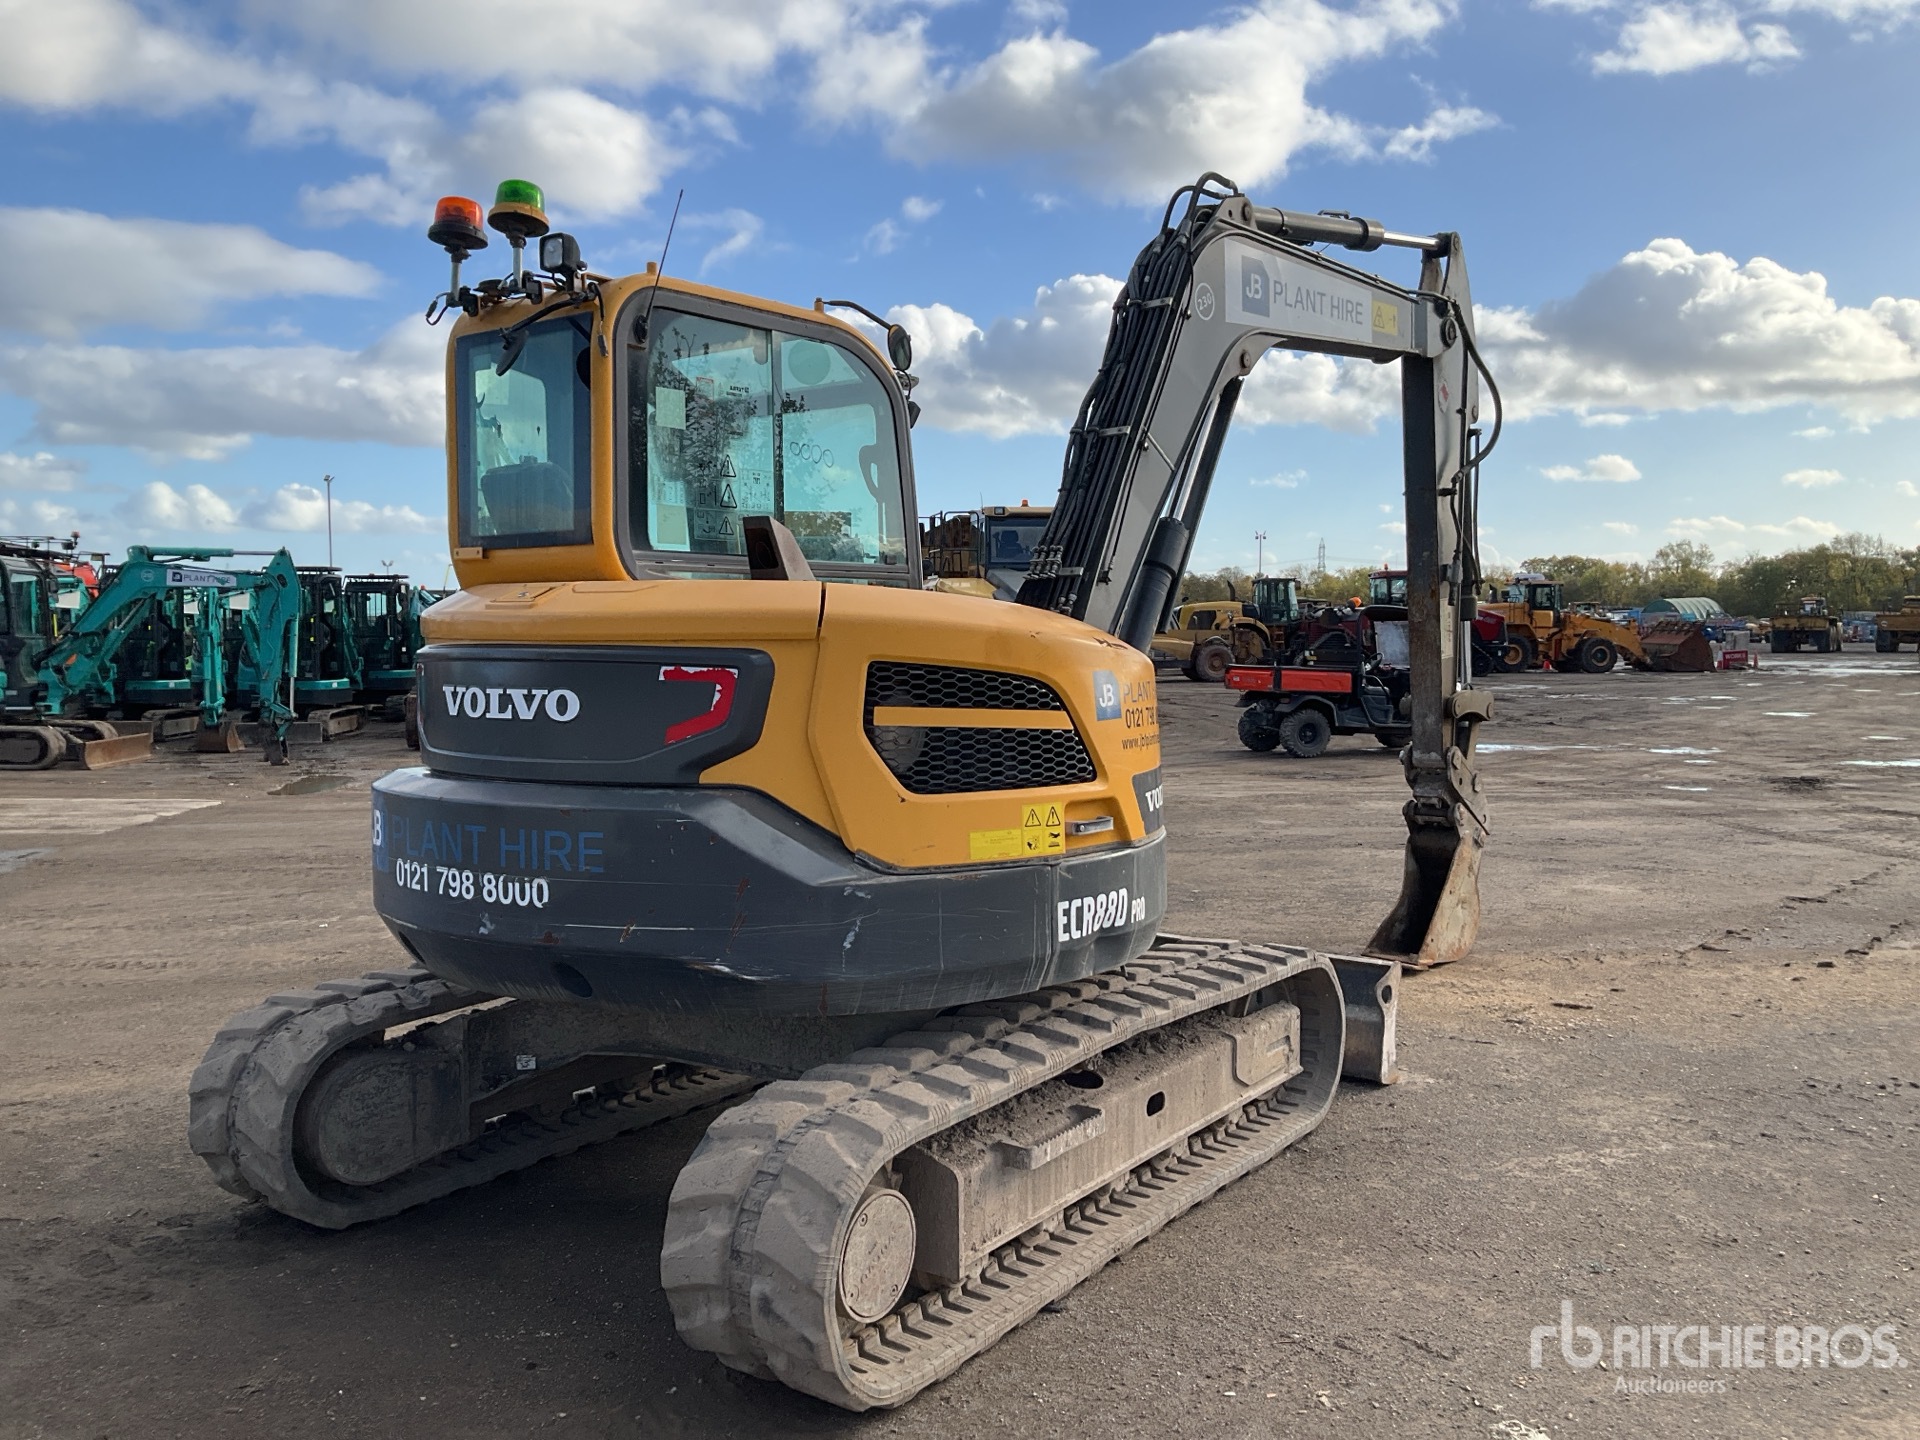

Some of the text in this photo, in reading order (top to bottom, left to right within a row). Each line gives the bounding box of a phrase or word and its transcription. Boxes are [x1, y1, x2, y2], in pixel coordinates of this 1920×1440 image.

[1197, 292, 1212, 311] 230
[1246, 273, 1364, 326] JB PLANT HIRE
[183, 573, 210, 584] PLANT
[442, 684, 581, 723] VOLVO
[1099, 683, 1115, 708] JB
[1123, 680, 1151, 704] PLANT
[1125, 706, 1145, 729] 0121
[391, 814, 487, 866] PLANT
[499, 827, 606, 874] HIRE
[395, 857, 429, 893] 0121
[435, 865, 476, 901] 798
[1057, 887, 1146, 943] ECR88D PRO
